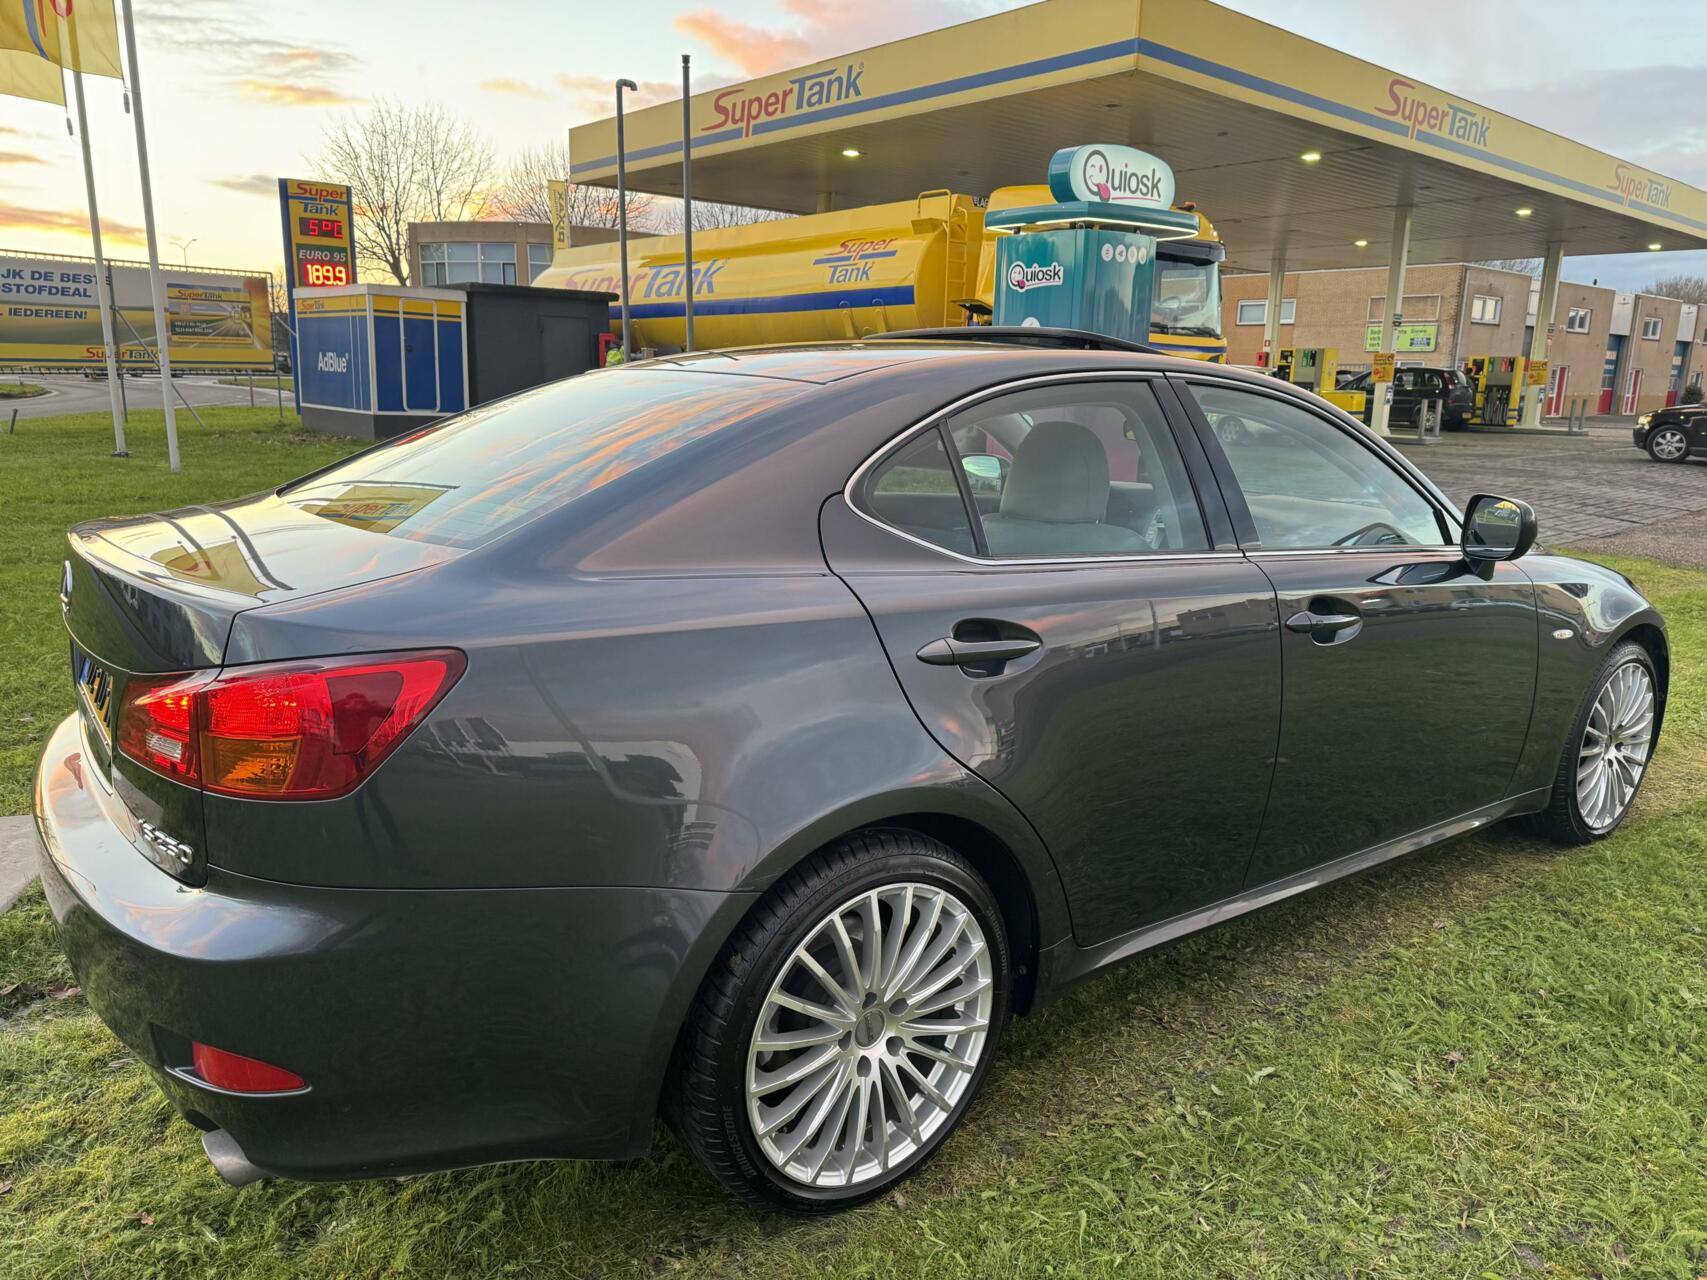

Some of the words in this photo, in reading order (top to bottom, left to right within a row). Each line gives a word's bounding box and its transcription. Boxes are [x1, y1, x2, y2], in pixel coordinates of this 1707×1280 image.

[701, 64, 864, 138] SuperTank
[1373, 78, 1491, 147] SuperTank
[1083, 150, 1161, 201] Quiosk
[1606, 163, 1672, 209] SuperTank
[290, 183, 345, 202] Super
[300, 201, 340, 216] Tank
[299, 249, 330, 260] EURO
[333, 252, 346, 262] 95
[823, 237, 898, 261] Super
[30, 270, 54, 282] DE
[306, 264, 346, 285] 189.9
[828, 261, 873, 284] Tank
[1010, 262, 1061, 289] Quiosk
[8, 307, 87, 319] IEDEREEN!
[80, 346, 160, 363] SurTank
[317, 351, 348, 373] AdBlue
